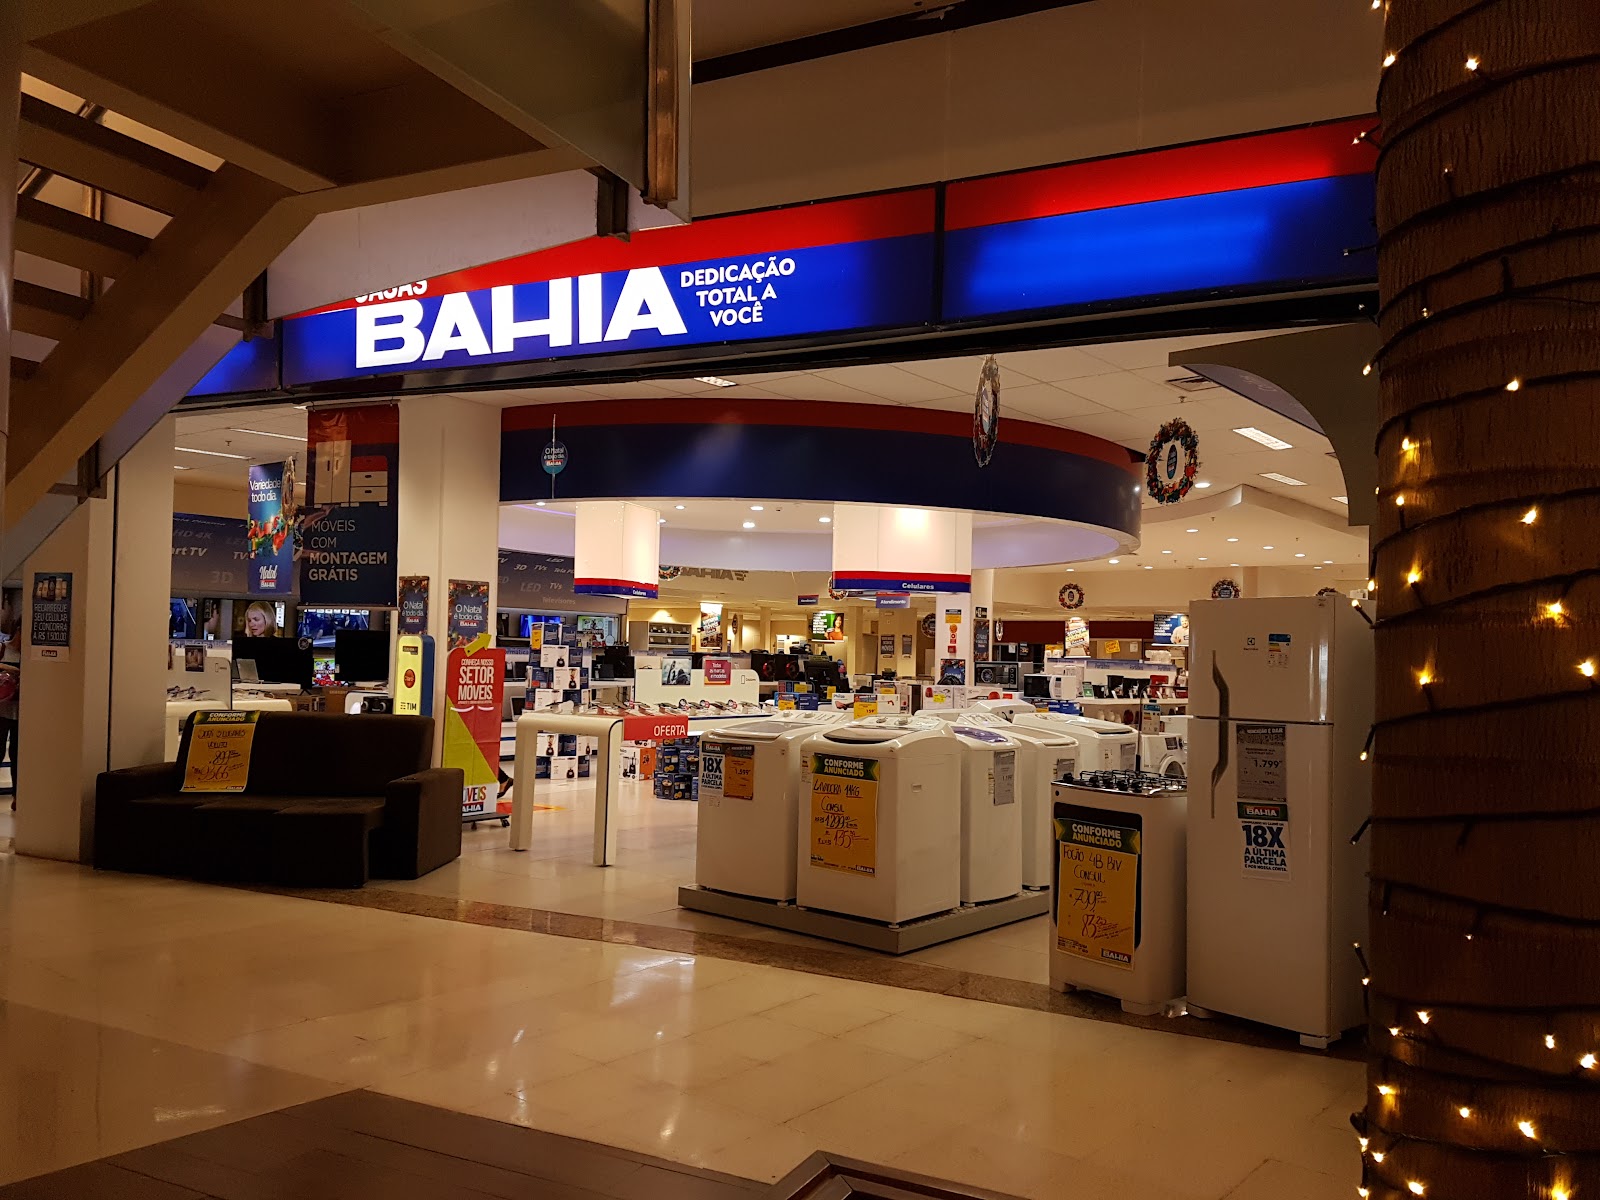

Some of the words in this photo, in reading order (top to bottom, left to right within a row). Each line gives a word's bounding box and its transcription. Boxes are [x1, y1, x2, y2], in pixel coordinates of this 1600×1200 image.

[680, 256, 796, 288] DEDICAÇÃO
[696, 285, 758, 307] TOTAL
[761, 282, 777, 300] A
[355, 266, 688, 368] BAHIA
[709, 300, 763, 327] VOCÊ
[251, 491, 266, 502] todo
[310, 519, 356, 532] MÓVEIS
[310, 536, 337, 549] COM
[190, 546, 208, 556] TV
[309, 552, 388, 565] MONTAGEM
[209, 570, 234, 584] 3D
[308, 566, 358, 581] GRÁTIS
[520, 582, 542, 592] LED
[549, 582, 563, 590] TVs
[403, 601, 408, 609] O
[409, 601, 423, 609] Natal
[542, 596, 576, 605] Televisores
[34, 603, 68, 613] RECARREGUE
[455, 604, 462, 613] O
[463, 605, 482, 613] Natal
[34, 613, 45, 622] SEU
[34, 622, 38, 630] E
[38, 622, 67, 631] CONCORRA
[459, 666, 494, 684] SETOR
[407, 702, 416, 711] TIM
[654, 724, 686, 737] OFERTA
[702, 757, 722, 773] 18X
[824, 758, 864, 769] CONFORME
[1254, 760, 1280, 768] 1.799
[824, 766, 864, 777] ANUNCIADO
[701, 779, 722, 787] PARCELA
[464, 786, 487, 802] VEIS
[1247, 807, 1277, 817] BAHIA
[1072, 824, 1121, 839] CONFORME
[1242, 825, 1285, 848] 18X
[1072, 832, 1122, 848] ANUNCIADO
[1253, 847, 1285, 858] ÚLTIMA
[1245, 856, 1286, 866] PARCELA
[1103, 950, 1129, 962] BAHIA
